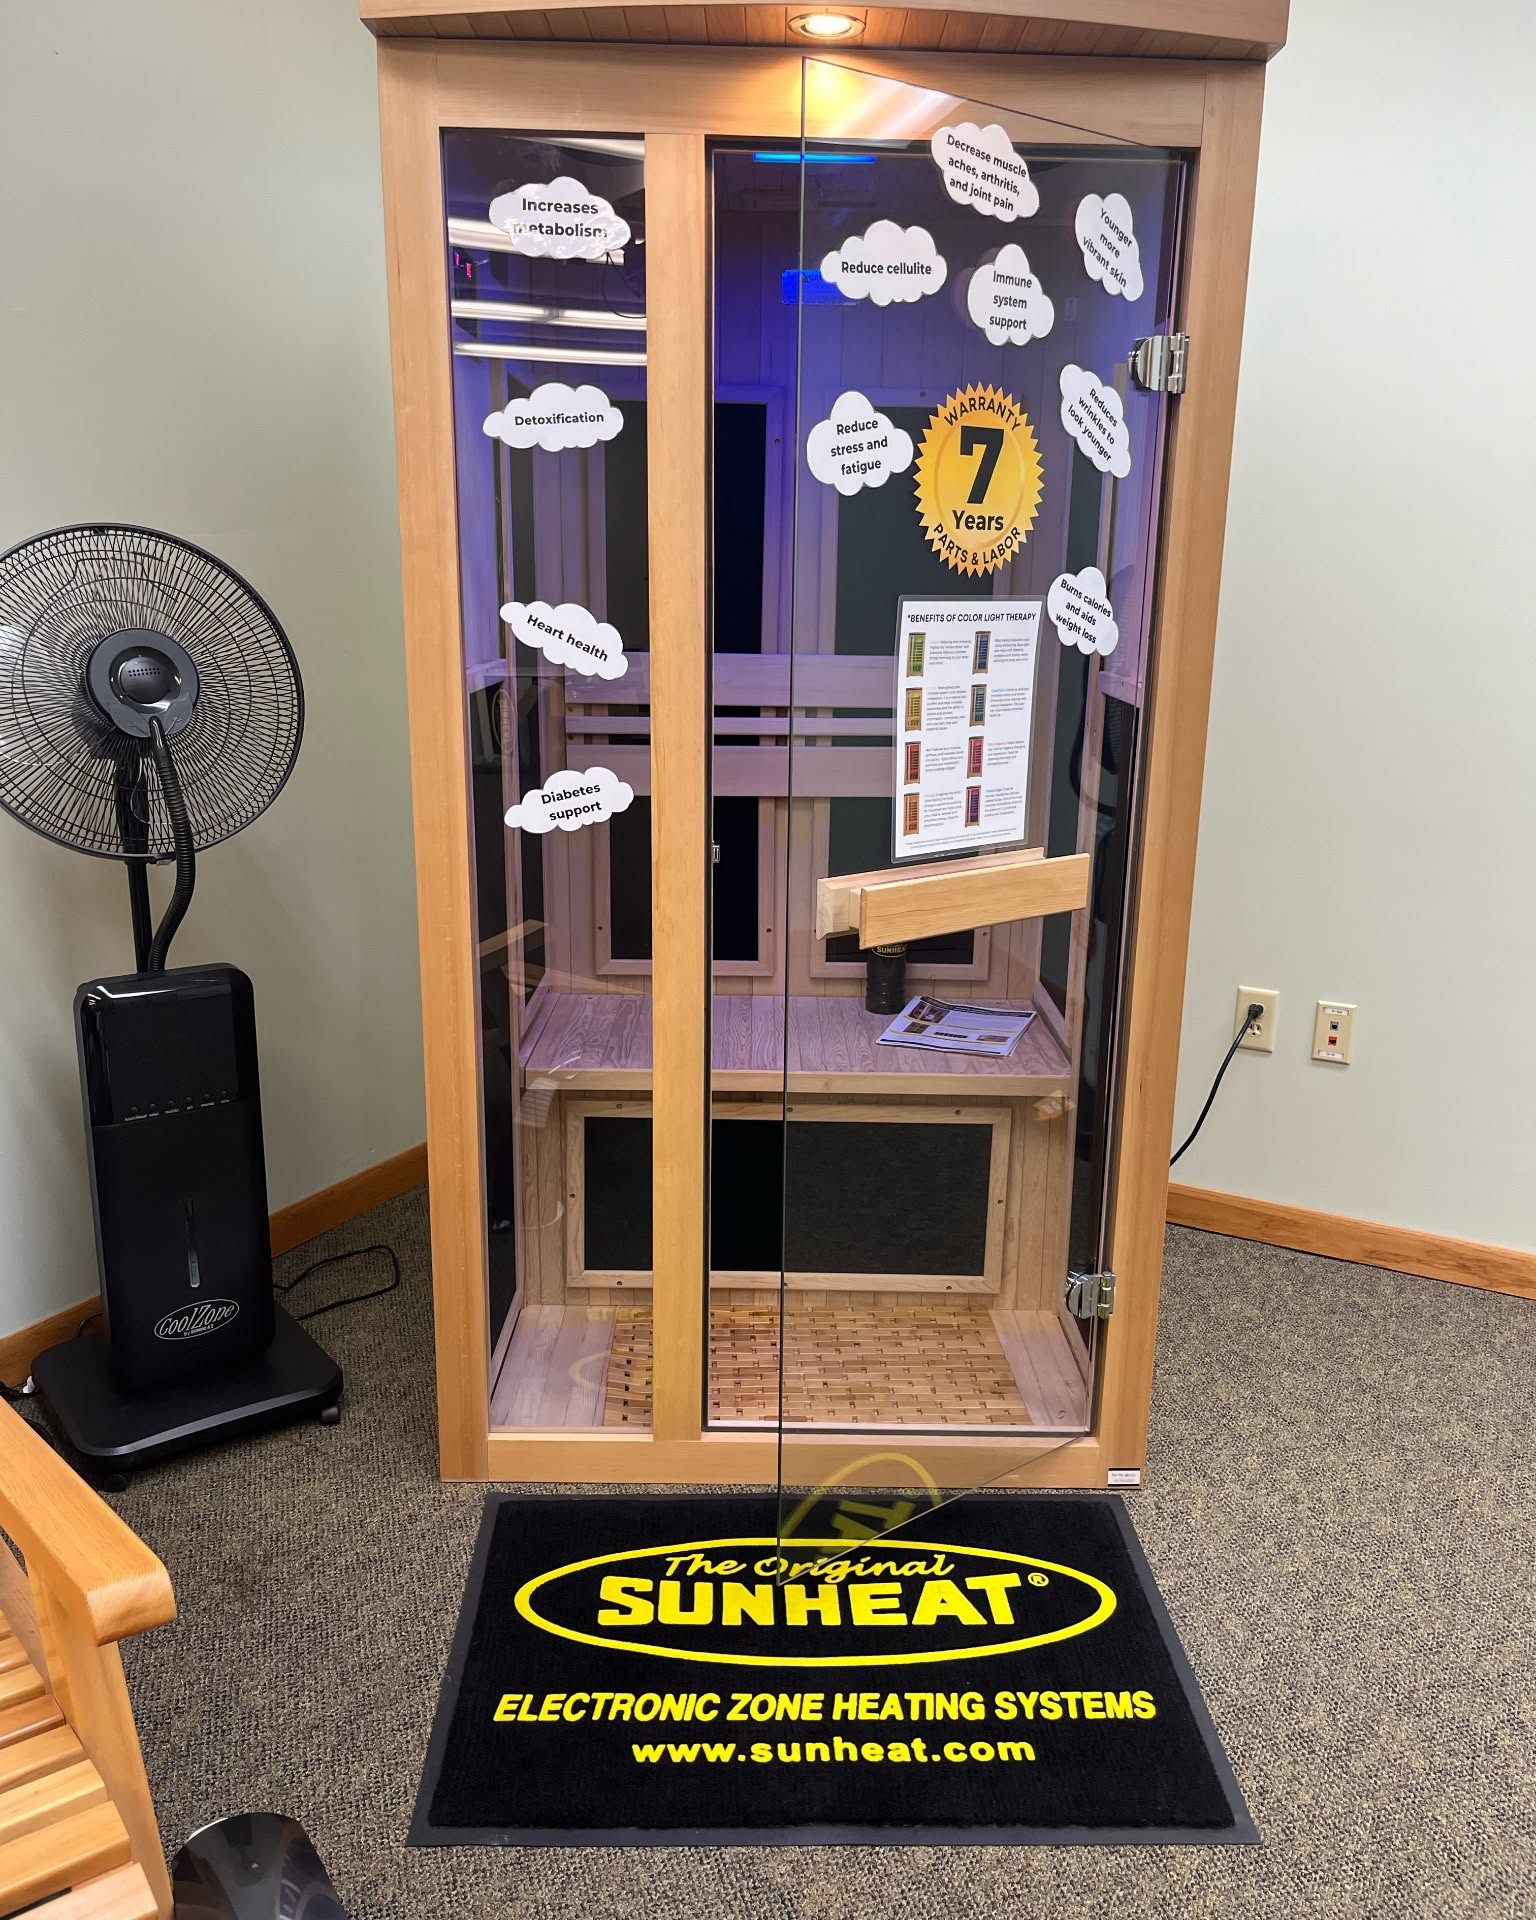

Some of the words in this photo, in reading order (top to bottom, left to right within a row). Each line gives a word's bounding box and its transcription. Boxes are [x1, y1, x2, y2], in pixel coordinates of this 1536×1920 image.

[947, 134, 991, 162] Decrease
[993, 156, 1026, 177] muscle
[948, 156, 979, 179] aches,
[981, 169, 1020, 196] arthritis,
[522, 198, 598, 214] Increases
[950, 177, 968, 193] and
[969, 182, 992, 203] joint
[993, 194, 1014, 212] pain
[513, 222, 607, 238] metabolism
[1100, 208, 1132, 248] Younger
[1100, 232, 1120, 258] more
[841, 261, 884, 275] Reduce
[887, 261, 932, 275] cellulite
[1082, 236, 1109, 271] vibrant
[1109, 265, 1127, 288] skin
[993, 271, 1032, 288] Immune
[993, 292, 1027, 310] system
[989, 314, 1027, 331] support
[515, 413, 604, 426] Detoxification
[944, 396, 1020, 430] WARRANTY
[1078, 396, 1108, 434] wrinkles
[1106, 431, 1116, 445] to
[1089, 388, 1118, 427] Reduces
[836, 419, 878, 436] Reduce
[1068, 404, 1083, 426] look
[1082, 423, 1111, 462] younger
[830, 441, 864, 457] stress
[867, 437, 888, 452] and
[841, 459, 882, 477] fatigue
[960, 426, 1004, 504] 7
[953, 510, 1004, 531] Years
[934, 523, 969, 564] PARTS
[971, 553, 979, 565] &
[983, 526, 1020, 564] LABOR
[1061, 579, 1082, 600] Burns
[1083, 594, 1111, 618] calories
[946, 614, 956, 622] OF
[958, 614, 982, 622] COLOR
[984, 613, 1004, 621] LIGHT
[1006, 613, 1036, 621] THERAPY
[1066, 601, 1080, 616] and
[1079, 609, 1096, 626] aids
[527, 615, 564, 639] Heart
[566, 633, 608, 661] health
[1056, 613, 1080, 638] weight
[1081, 627, 1097, 644] loss
[541, 784, 601, 804] Diabetes
[550, 801, 602, 820] support
[160, 1304, 234, 1335] CoolZone
[665, 1553, 745, 1575] The
[755, 1553, 954, 1583] Original
[493, 1692, 722, 1722] ELECTRONIC
[726, 1692, 823, 1722] ZONE
[832, 1692, 985, 1722] HEATING
[993, 1692, 1156, 1722] SYSTEMS
[632, 1737, 1035, 1763] www.sunheat.com
